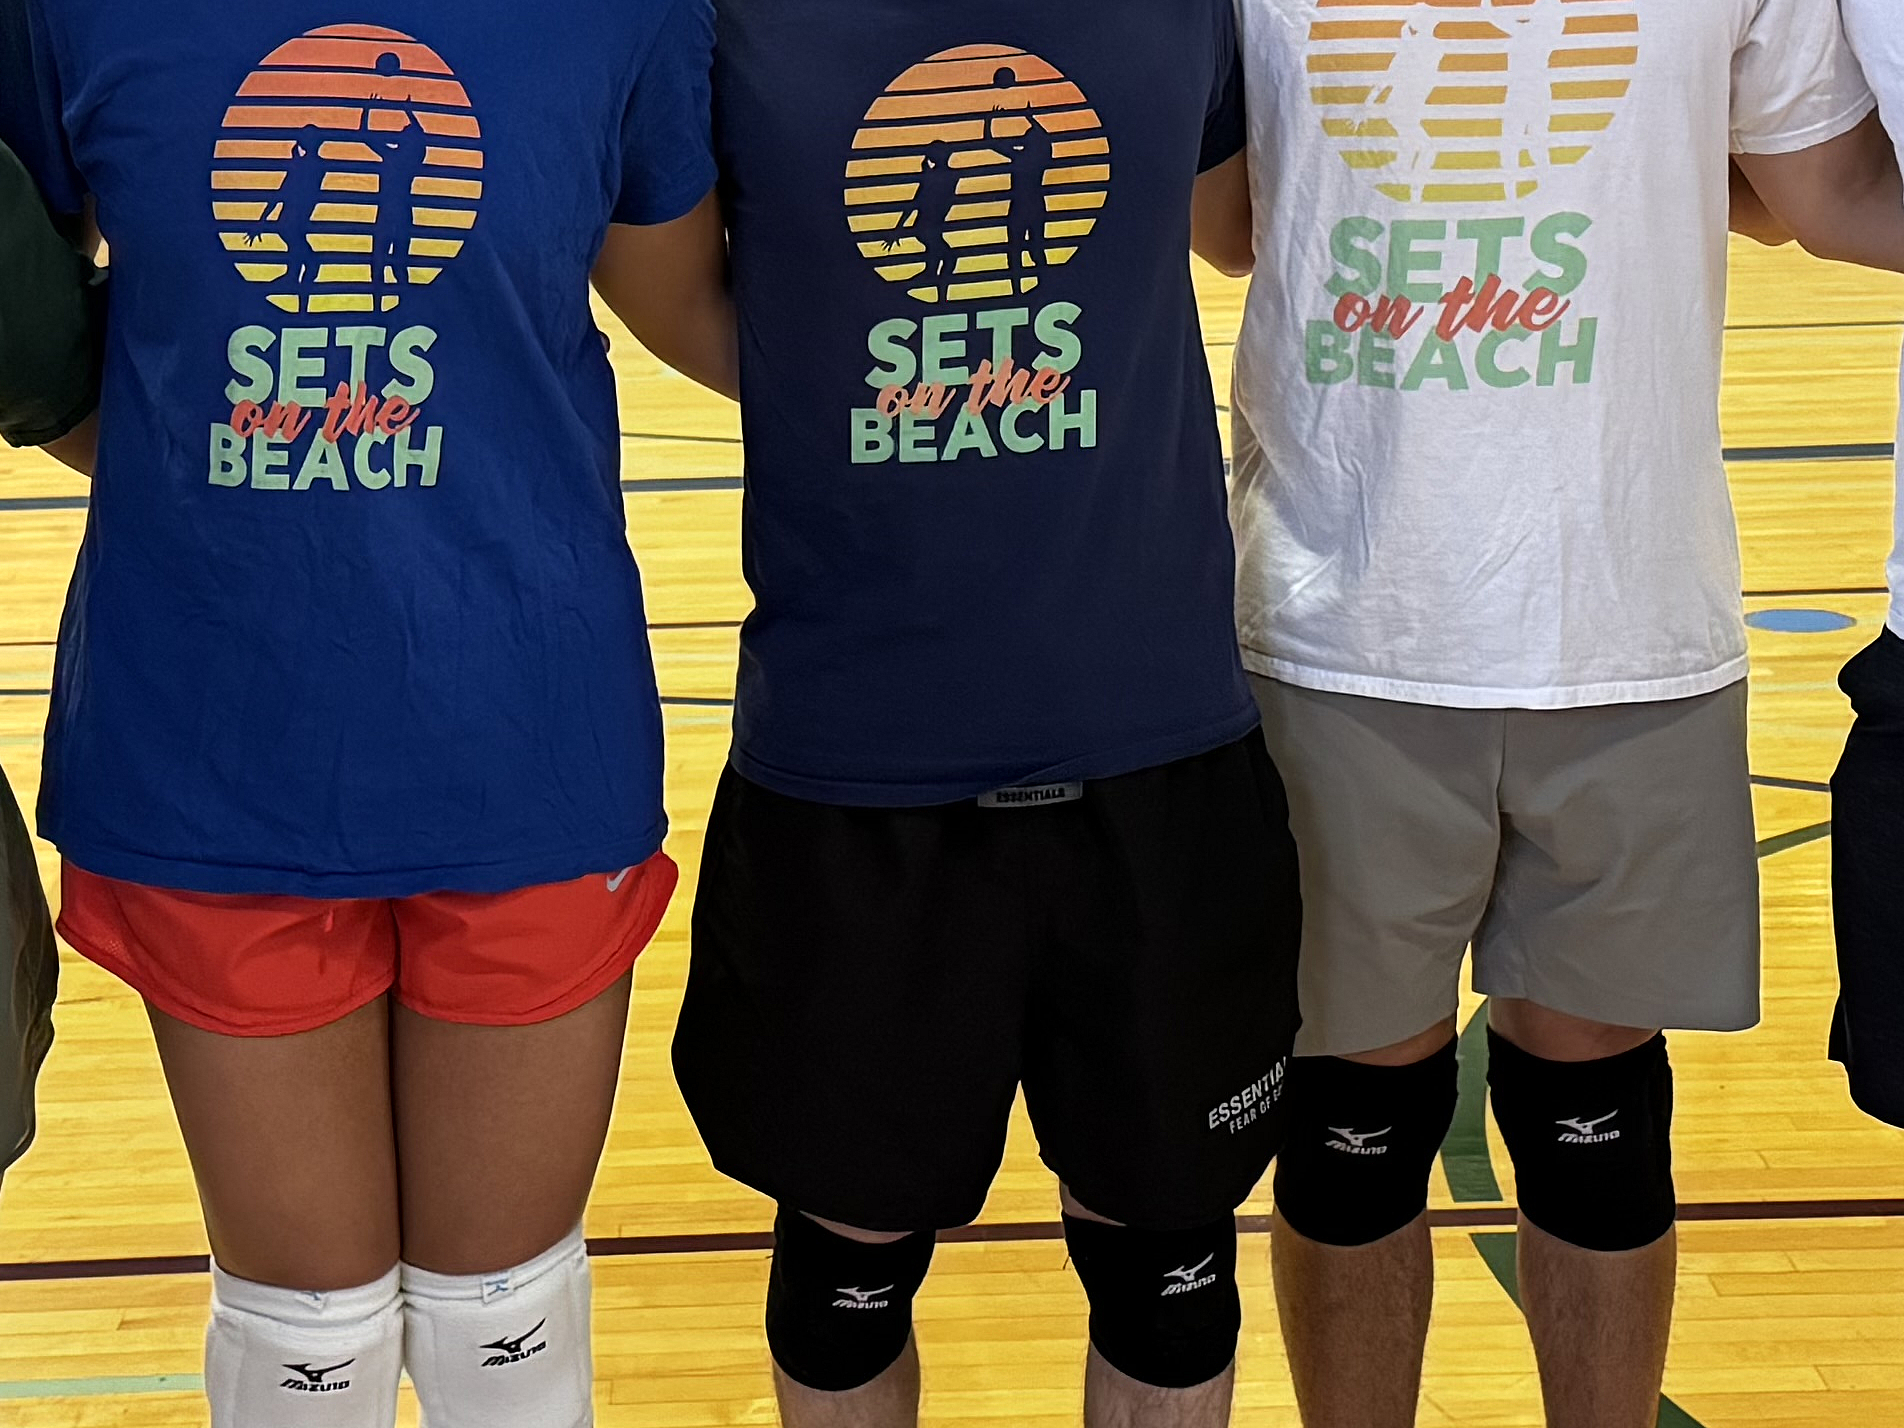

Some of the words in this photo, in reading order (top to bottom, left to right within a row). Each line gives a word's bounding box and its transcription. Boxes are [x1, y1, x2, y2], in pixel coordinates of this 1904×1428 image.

[1324, 211, 1593, 304] SETS
[1333, 291, 1424, 341] on
[1435, 272, 1571, 342] the
[224, 325, 438, 408] SETS
[865, 301, 1082, 389] SETS
[1304, 316, 1598, 391] BEACH
[229, 399, 311, 443] on
[323, 380, 420, 443] the
[875, 381, 957, 420] on
[968, 356, 1071, 416] the
[208, 422, 443, 491] BEACH
[851, 389, 1096, 464] BEACH
[1229, 1107, 1257, 1134] FEAR
